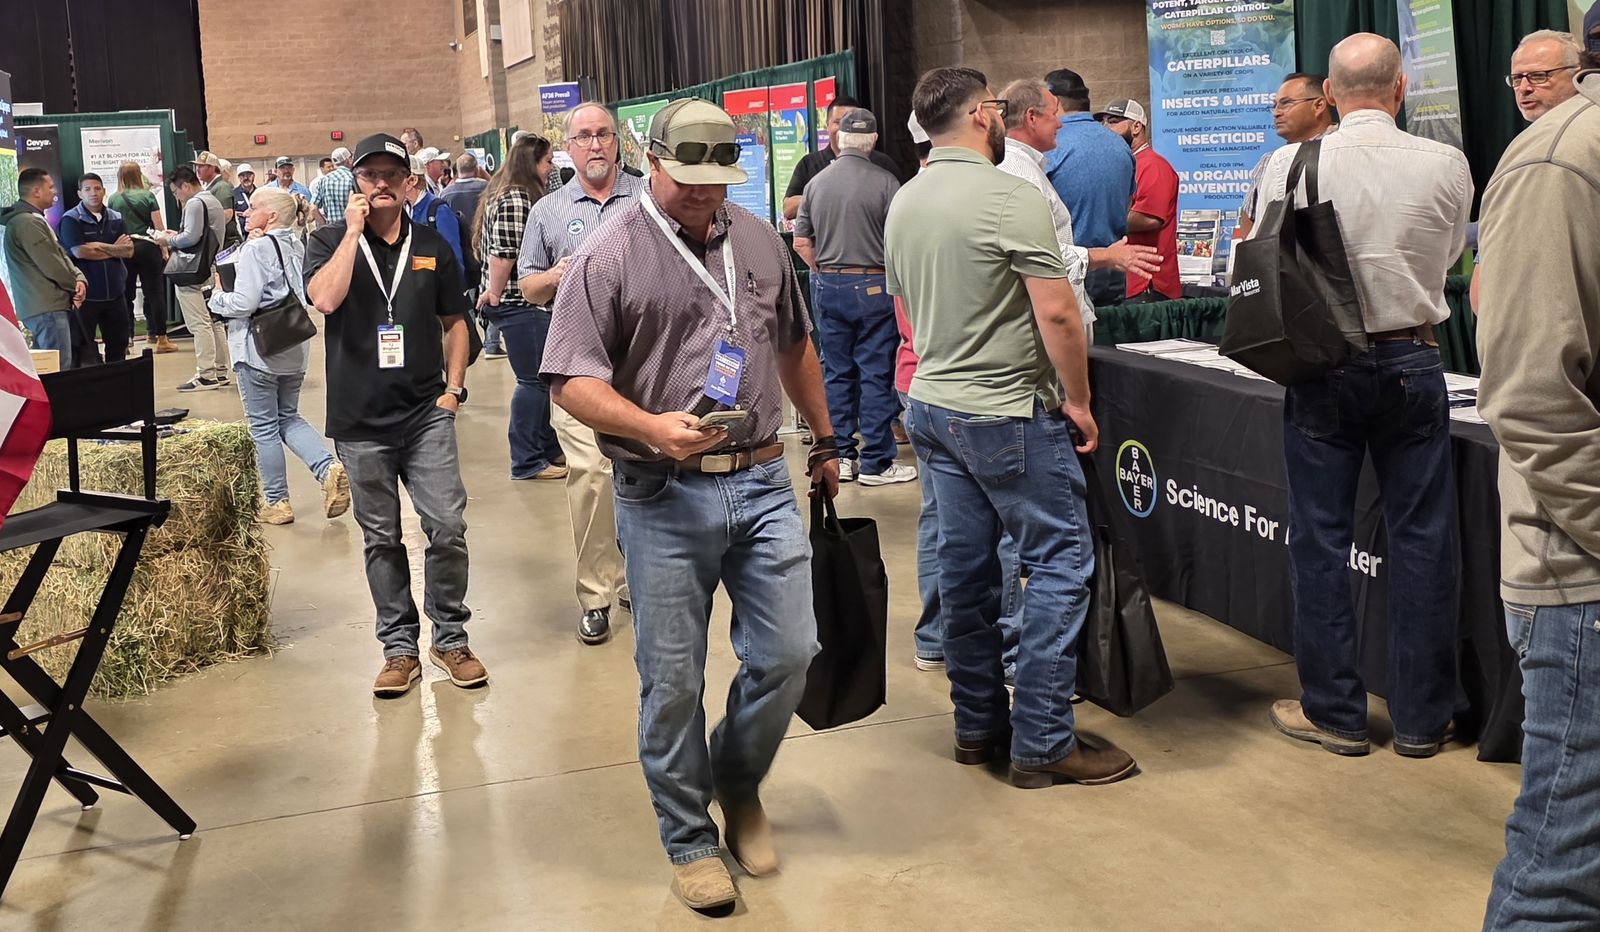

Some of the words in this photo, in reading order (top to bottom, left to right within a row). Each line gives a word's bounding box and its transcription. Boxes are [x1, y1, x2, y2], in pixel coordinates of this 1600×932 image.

[1152, 0, 1188, 9] POTENT,
[1164, 8, 1225, 19] CATERPILLAR
[1226, 3, 1270, 13] CONTROL.
[1161, 22, 1185, 30] WORMS
[1182, 50, 1215, 58] EXCELLENT
[1217, 48, 1244, 56] CONTROL
[1167, 54, 1270, 72] CATERPILLARS
[1162, 96, 1218, 109] INSECTS
[1222, 95, 1232, 106] &
[1236, 93, 1275, 105] MITES
[1178, 132, 1265, 146] INSECTICIDE
[1119, 467, 1153, 490] BAYER
[1131, 446, 1142, 511] BAYER
[1166, 479, 1240, 527] Science
[1244, 504, 1279, 541] For
